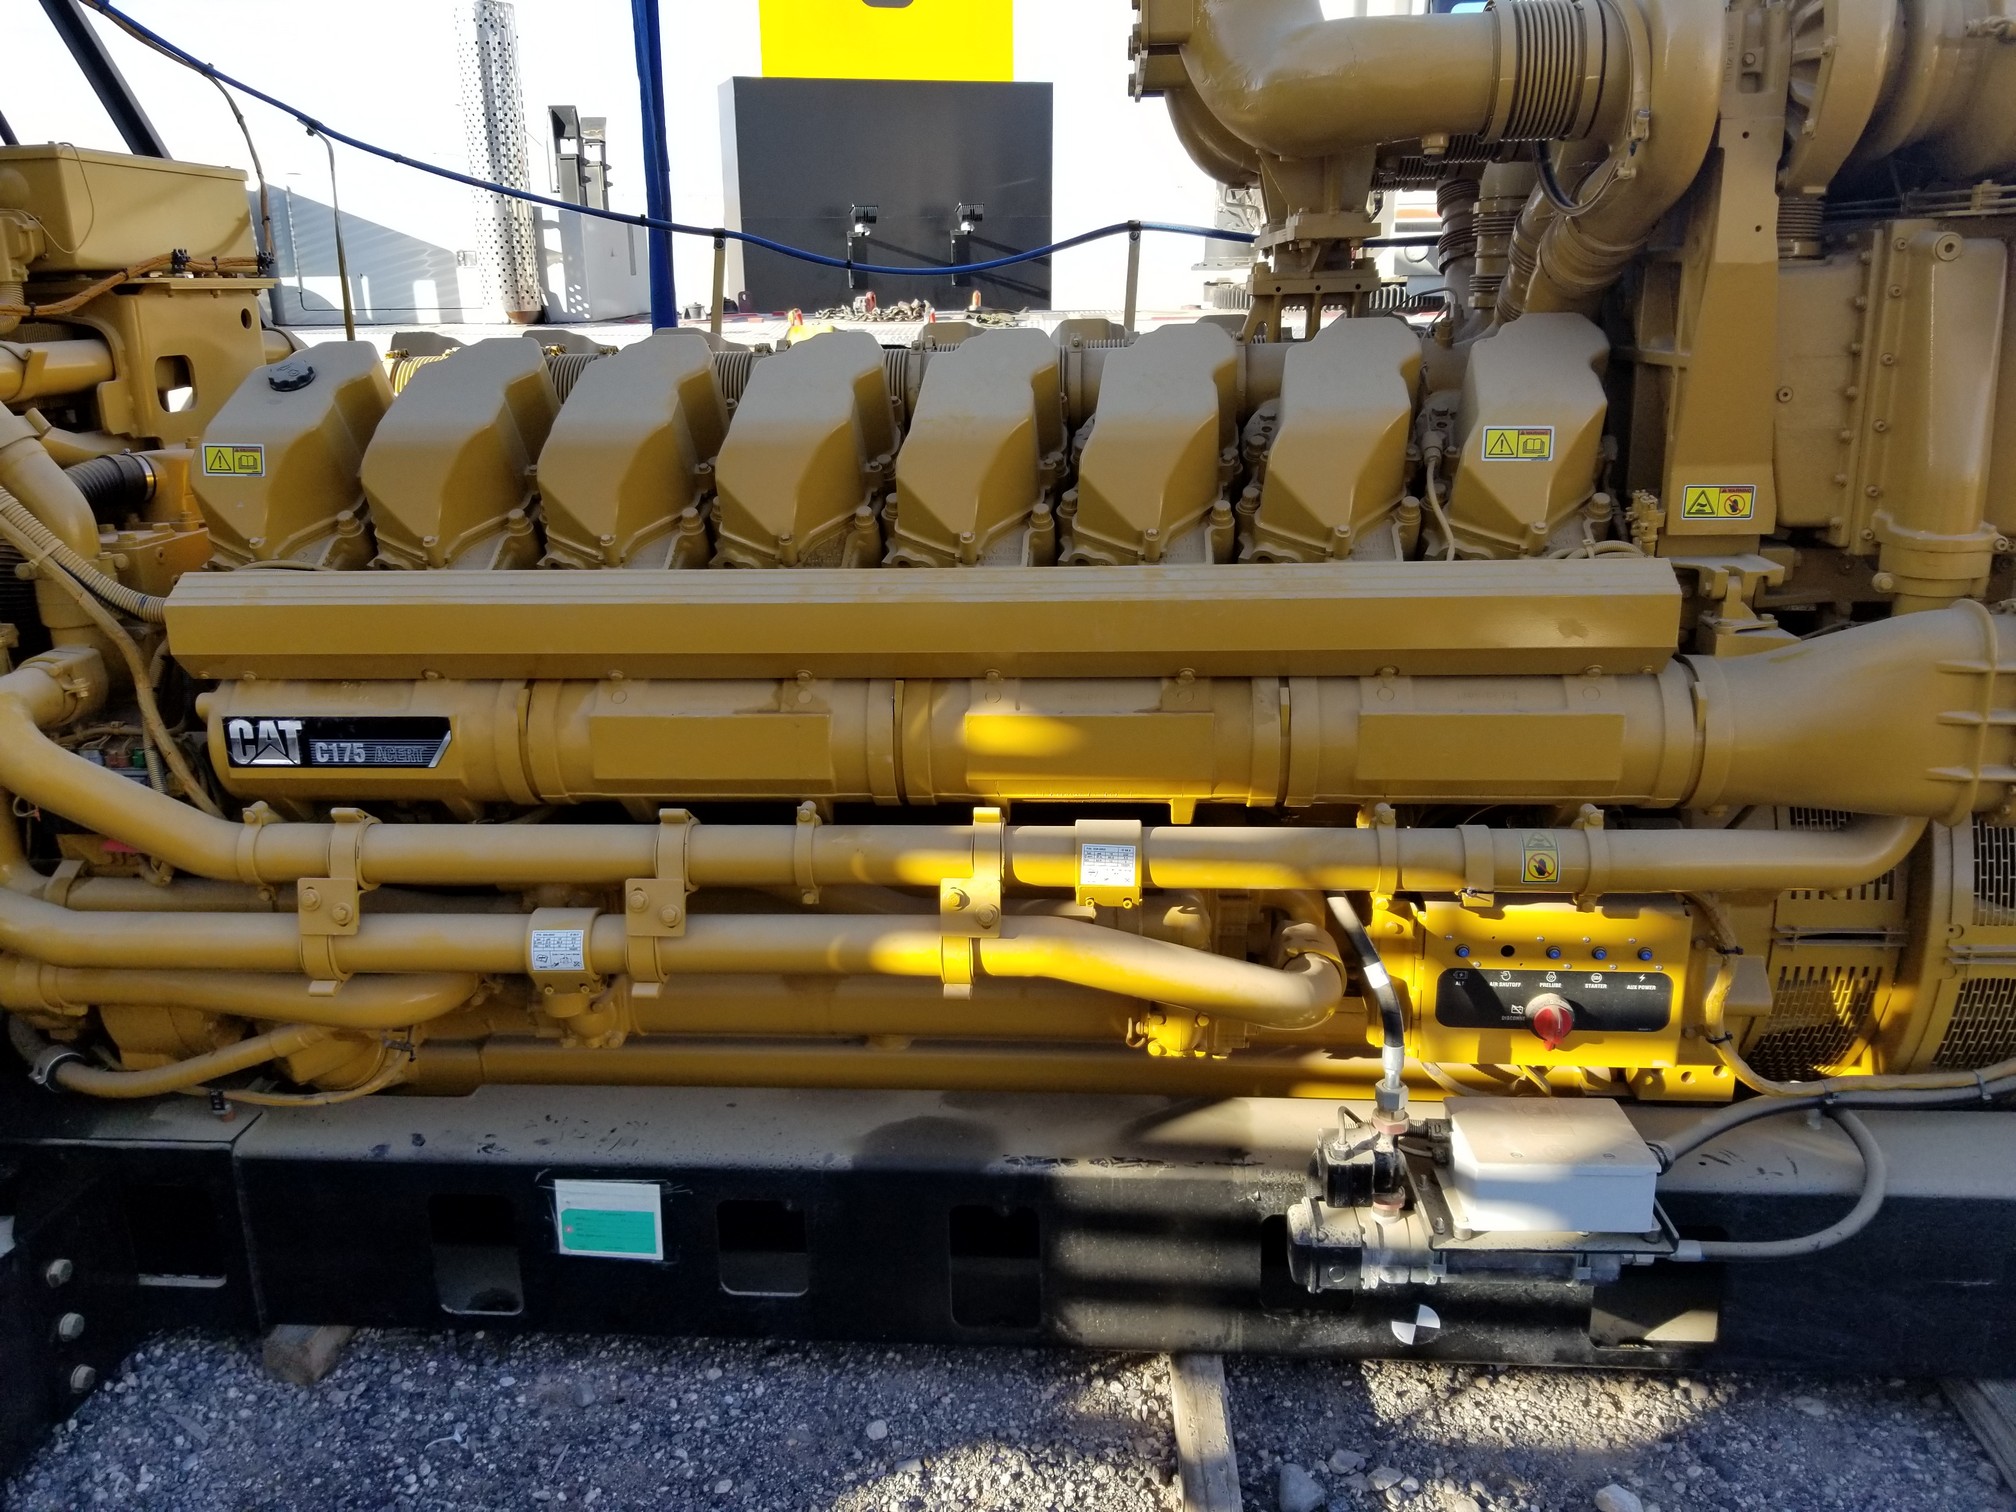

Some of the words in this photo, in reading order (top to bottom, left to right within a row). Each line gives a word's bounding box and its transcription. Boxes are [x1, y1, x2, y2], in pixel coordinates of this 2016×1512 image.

[228, 718, 302, 765] CAT
[315, 741, 366, 763] C175
[374, 746, 427, 763] ACERT
